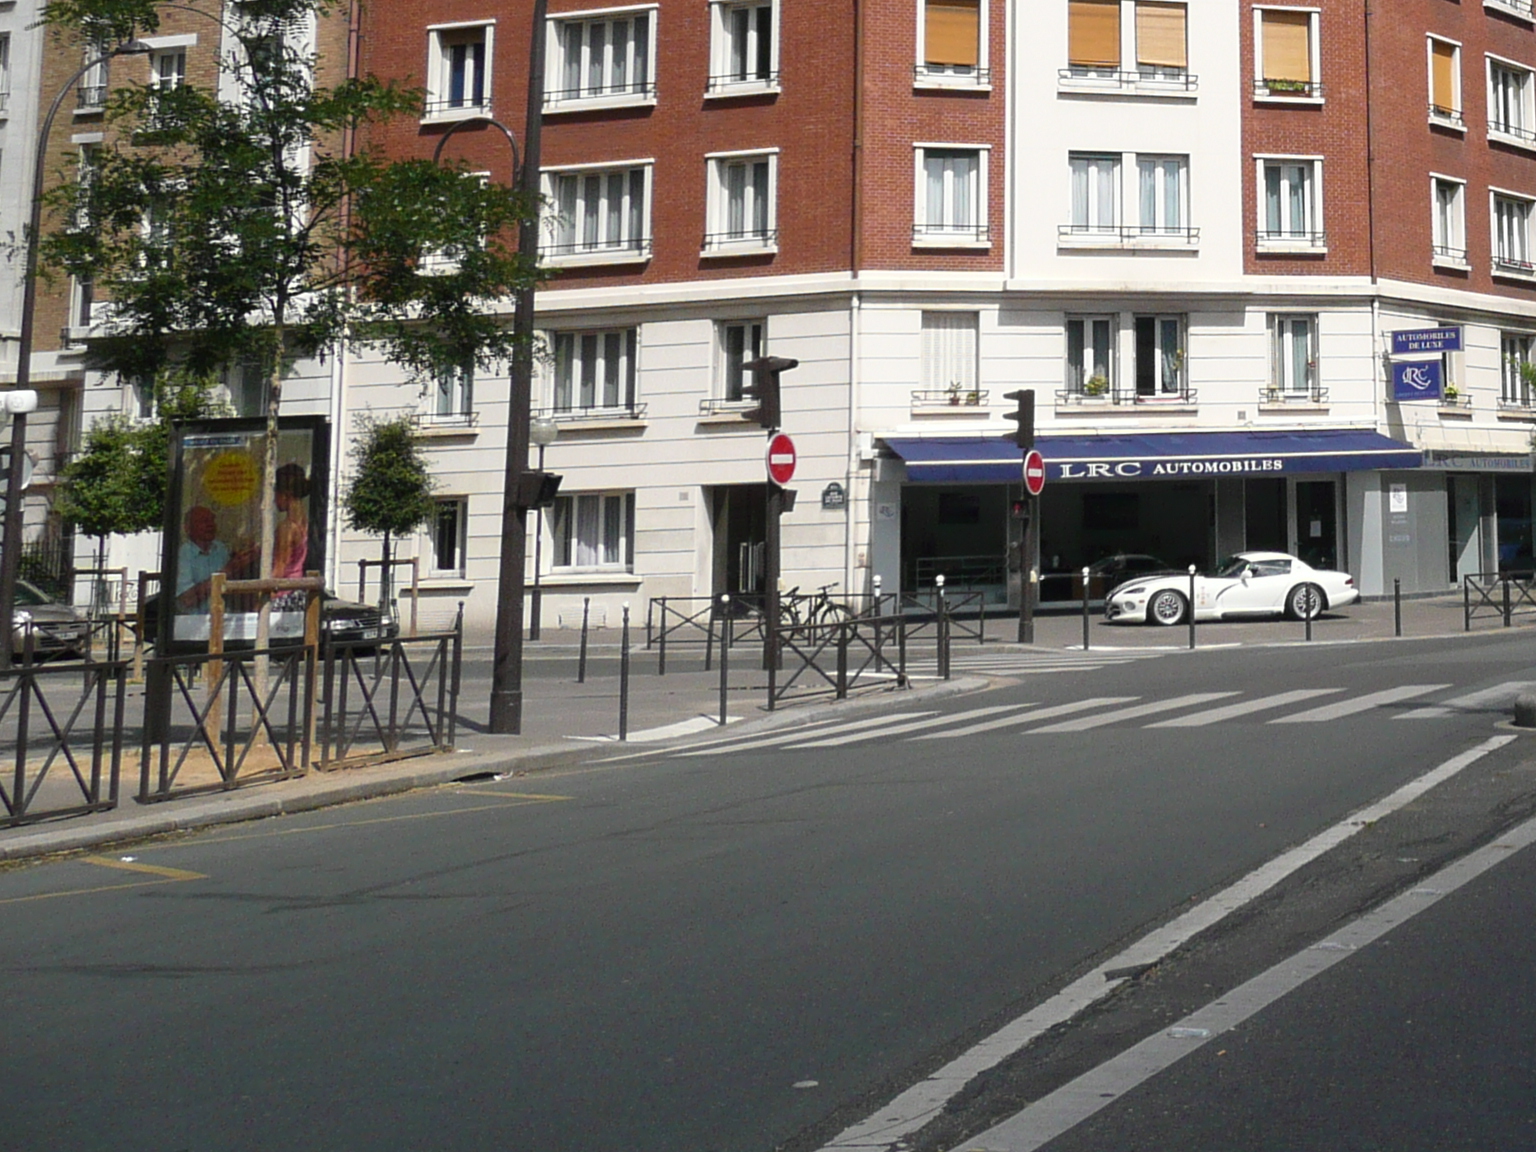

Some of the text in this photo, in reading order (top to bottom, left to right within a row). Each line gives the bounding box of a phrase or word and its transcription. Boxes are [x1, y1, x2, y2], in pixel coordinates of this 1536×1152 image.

[1397, 332, 1456, 342] AUTOMOBILES
[1421, 341, 1444, 349] LUXE
[1060, 460, 1283, 478] LRC AUTOMOBILES
